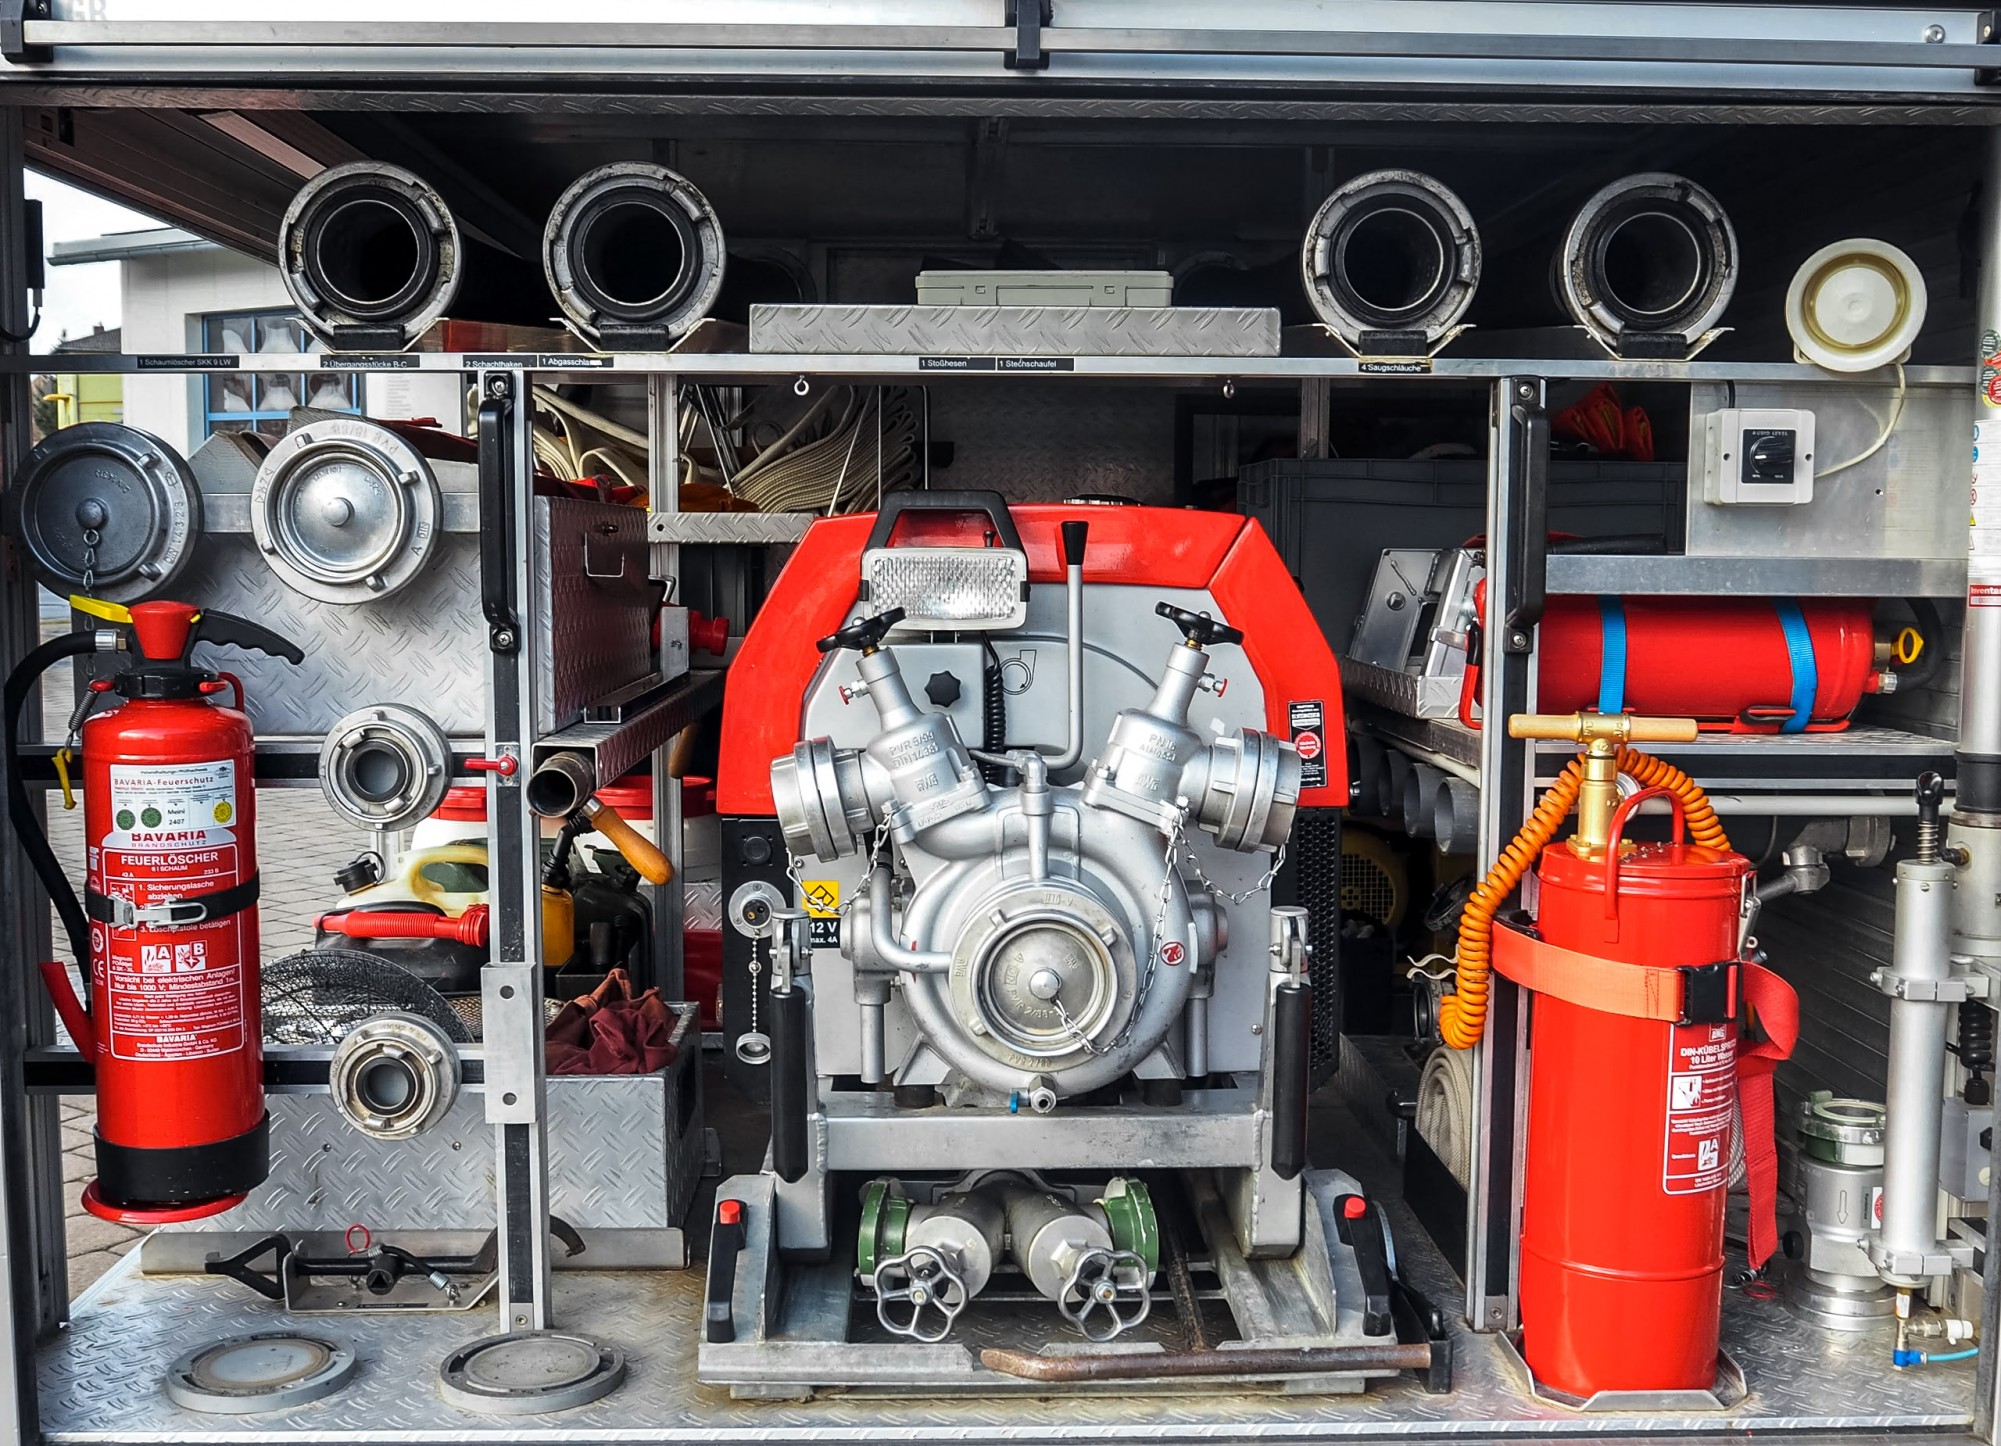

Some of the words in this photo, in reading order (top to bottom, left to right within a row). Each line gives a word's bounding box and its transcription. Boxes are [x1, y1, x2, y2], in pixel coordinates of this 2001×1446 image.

[145, 358, 195, 367] Schaumlöscher
[197, 358, 212, 366] SKK
[219, 358, 231, 366] LW
[472, 360, 523, 368] Schachthaken
[1005, 359, 1056, 367] Stechschaufel
[1368, 363, 1421, 372] Saugschläuche
[132, 830, 206, 841] BAVARIA
[131, 840, 207, 848] BRANDSCHUTZ
[121, 851, 219, 866] FEUERLÖSCHER
[147, 880, 214, 892] Sicherungslasche
[199, 919, 231, 930] betätigen
[810, 922, 824, 933] 12
[827, 922, 837, 933] V
[827, 936, 838, 944] 4A
[157, 946, 170, 959] A
[193, 943, 205, 955] B
[114, 975, 140, 983] Vorsicht
[157, 975, 204, 984] elektrischen
[206, 967, 236, 979] Anlagen!
[168, 979, 223, 990] Mindestabstand
[156, 1034, 196, 1043] BAVARIA
[1691, 1056, 1700, 1065] 10
